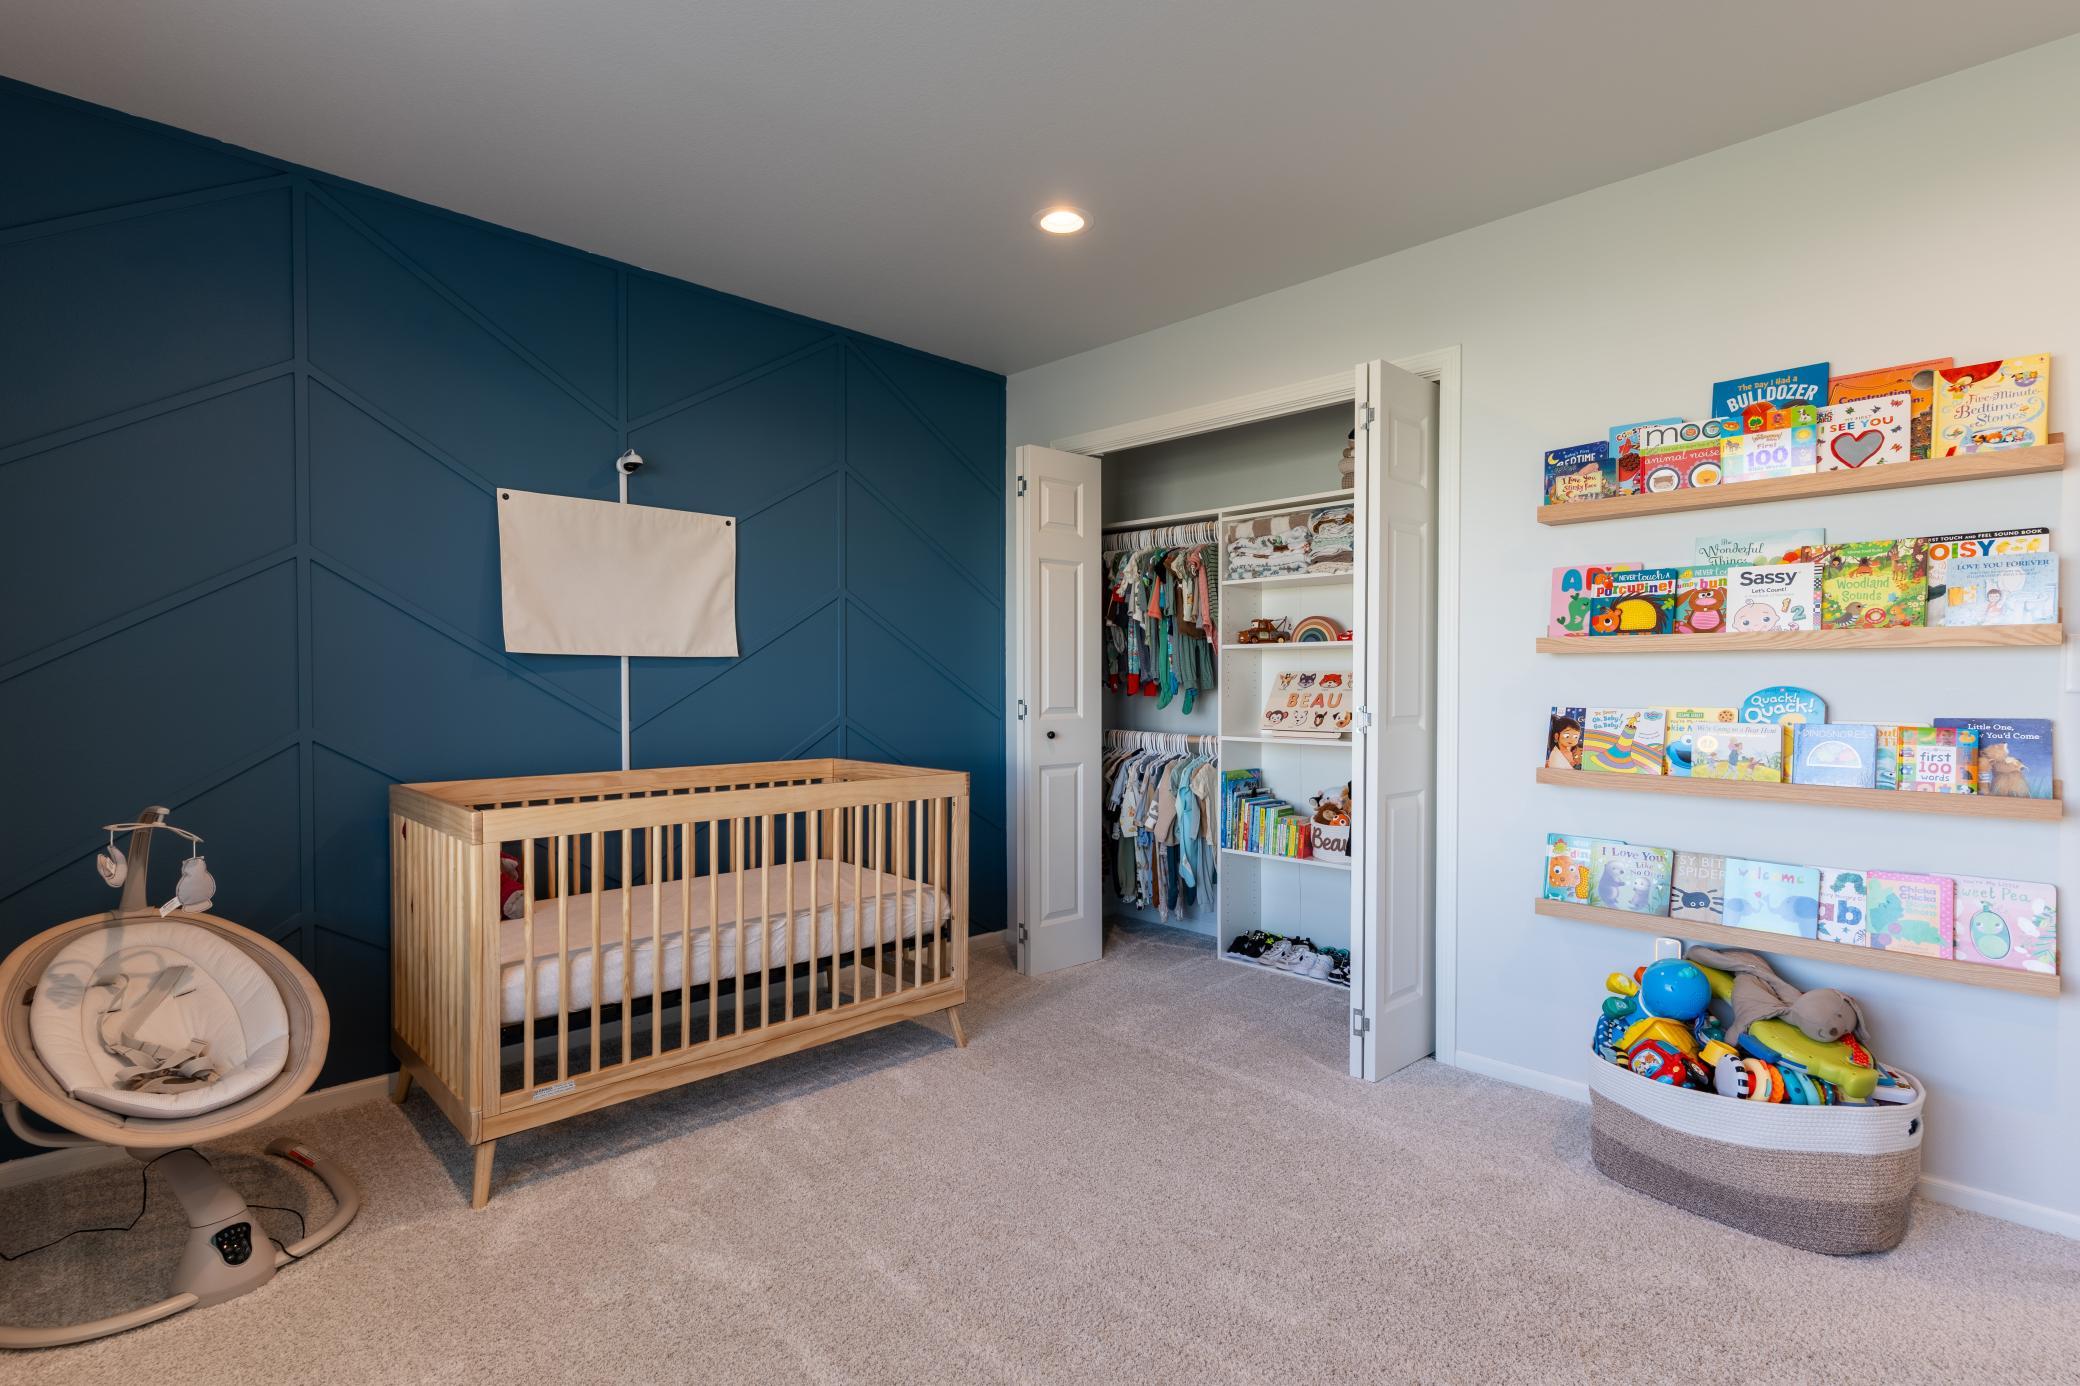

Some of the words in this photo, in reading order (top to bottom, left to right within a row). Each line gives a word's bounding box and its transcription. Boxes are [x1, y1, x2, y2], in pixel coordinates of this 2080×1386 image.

[1726, 384, 1819, 412] BULLDOZER
[1954, 401, 2017, 419] Bedtime
[1830, 421, 1855, 432] SEE
[1861, 415, 1894, 428] YOU
[1974, 412, 2025, 427] Stories
[1644, 451, 1687, 465] animal
[1746, 446, 1788, 467] 100
[1699, 542, 1765, 558] Wonderful
[1929, 539, 1996, 561] OISY
[1957, 563, 1978, 571] LOVE
[1983, 561, 2003, 569] YOU
[2005, 558, 2049, 568] FOREVER
[1618, 574, 1637, 582] NEVER
[1638, 570, 1666, 581] touch
[1740, 571, 1797, 586] Sassy
[1836, 576, 1890, 590] Woodland
[1841, 590, 1882, 602] Sounds
[1286, 692, 1343, 708] BEAU
[1751, 692, 1797, 707] Quack!
[1744, 698, 1814, 723] Quack!
[1920, 752, 1951, 762] first
[1919, 762, 1951, 774] 100
[1612, 847, 1640, 859] Love
[1642, 851, 1665, 862] You
